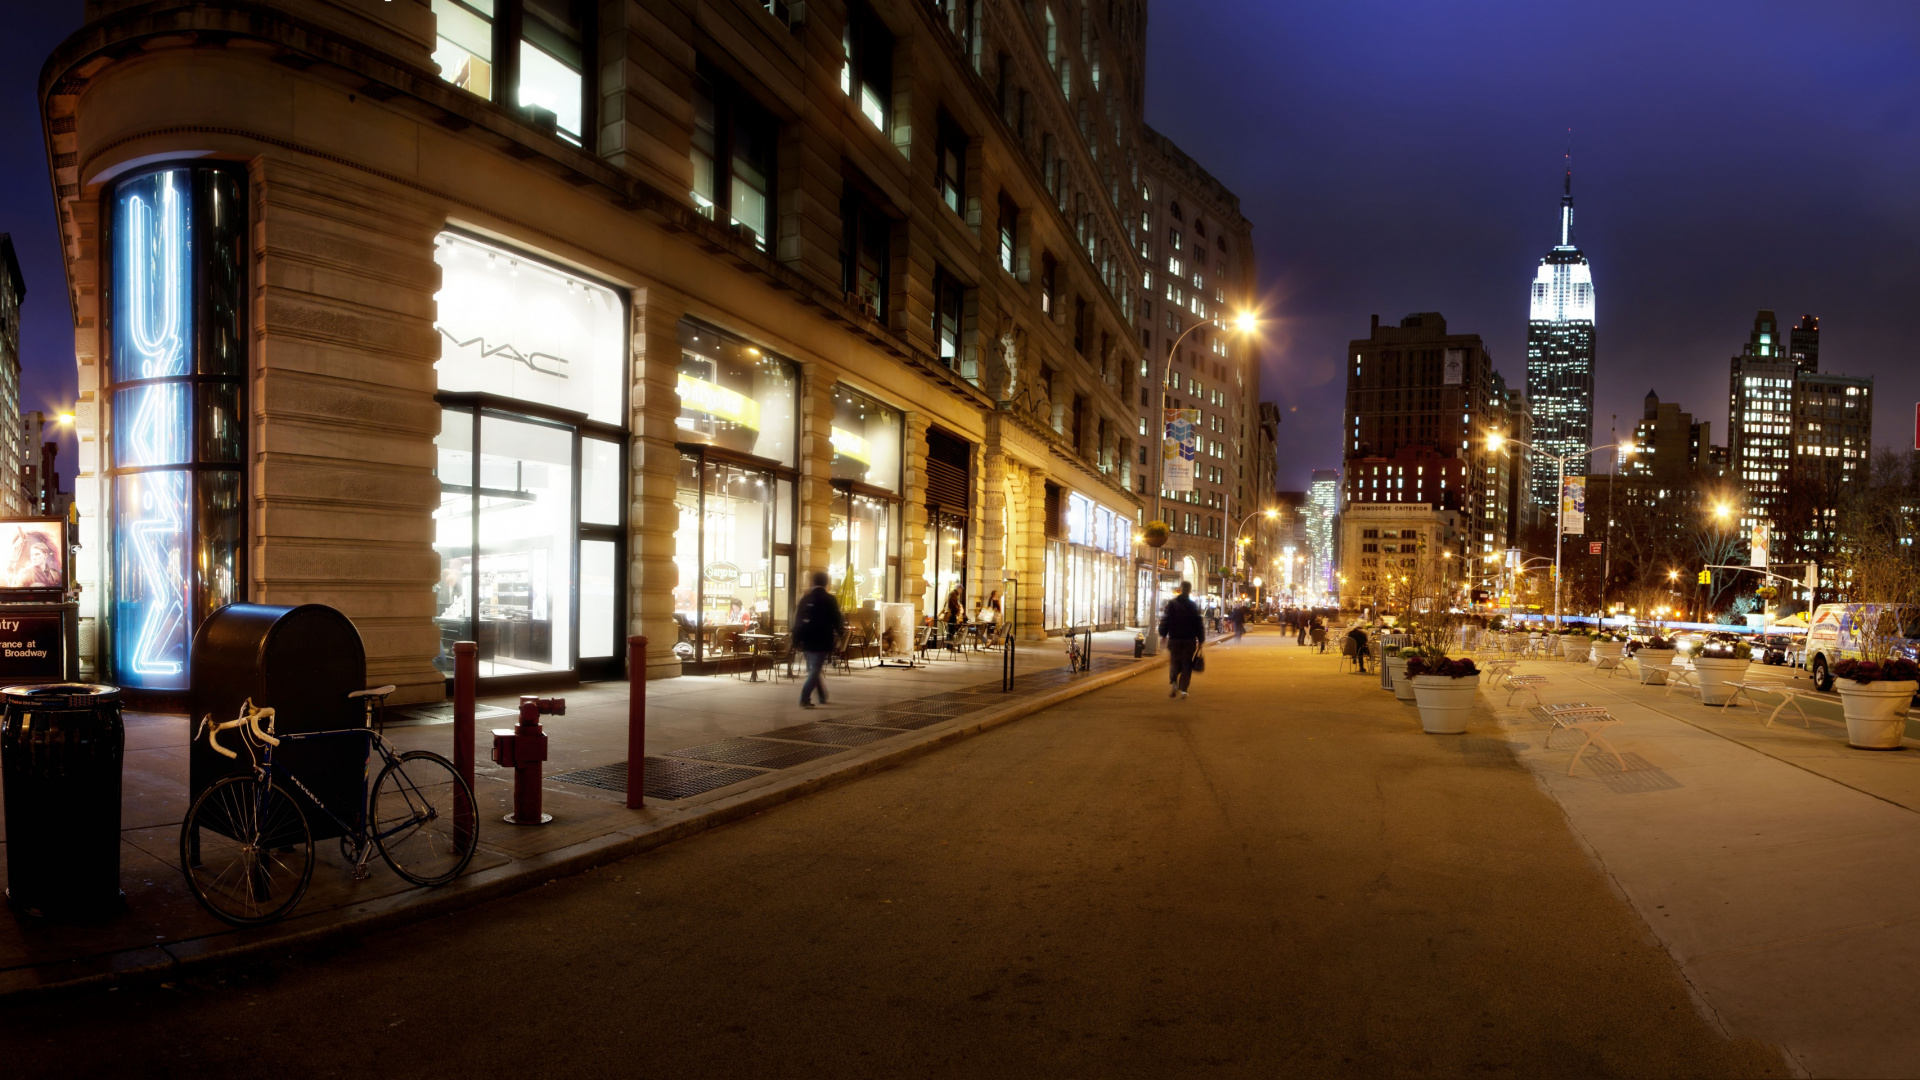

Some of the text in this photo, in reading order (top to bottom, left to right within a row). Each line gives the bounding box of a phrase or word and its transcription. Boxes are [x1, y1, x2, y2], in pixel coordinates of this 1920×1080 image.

[713, 568, 738, 580] argo tea
[0, 619, 19, 632] try
[27, 640, 36, 648] at
[5, 649, 47, 658] Broadway
